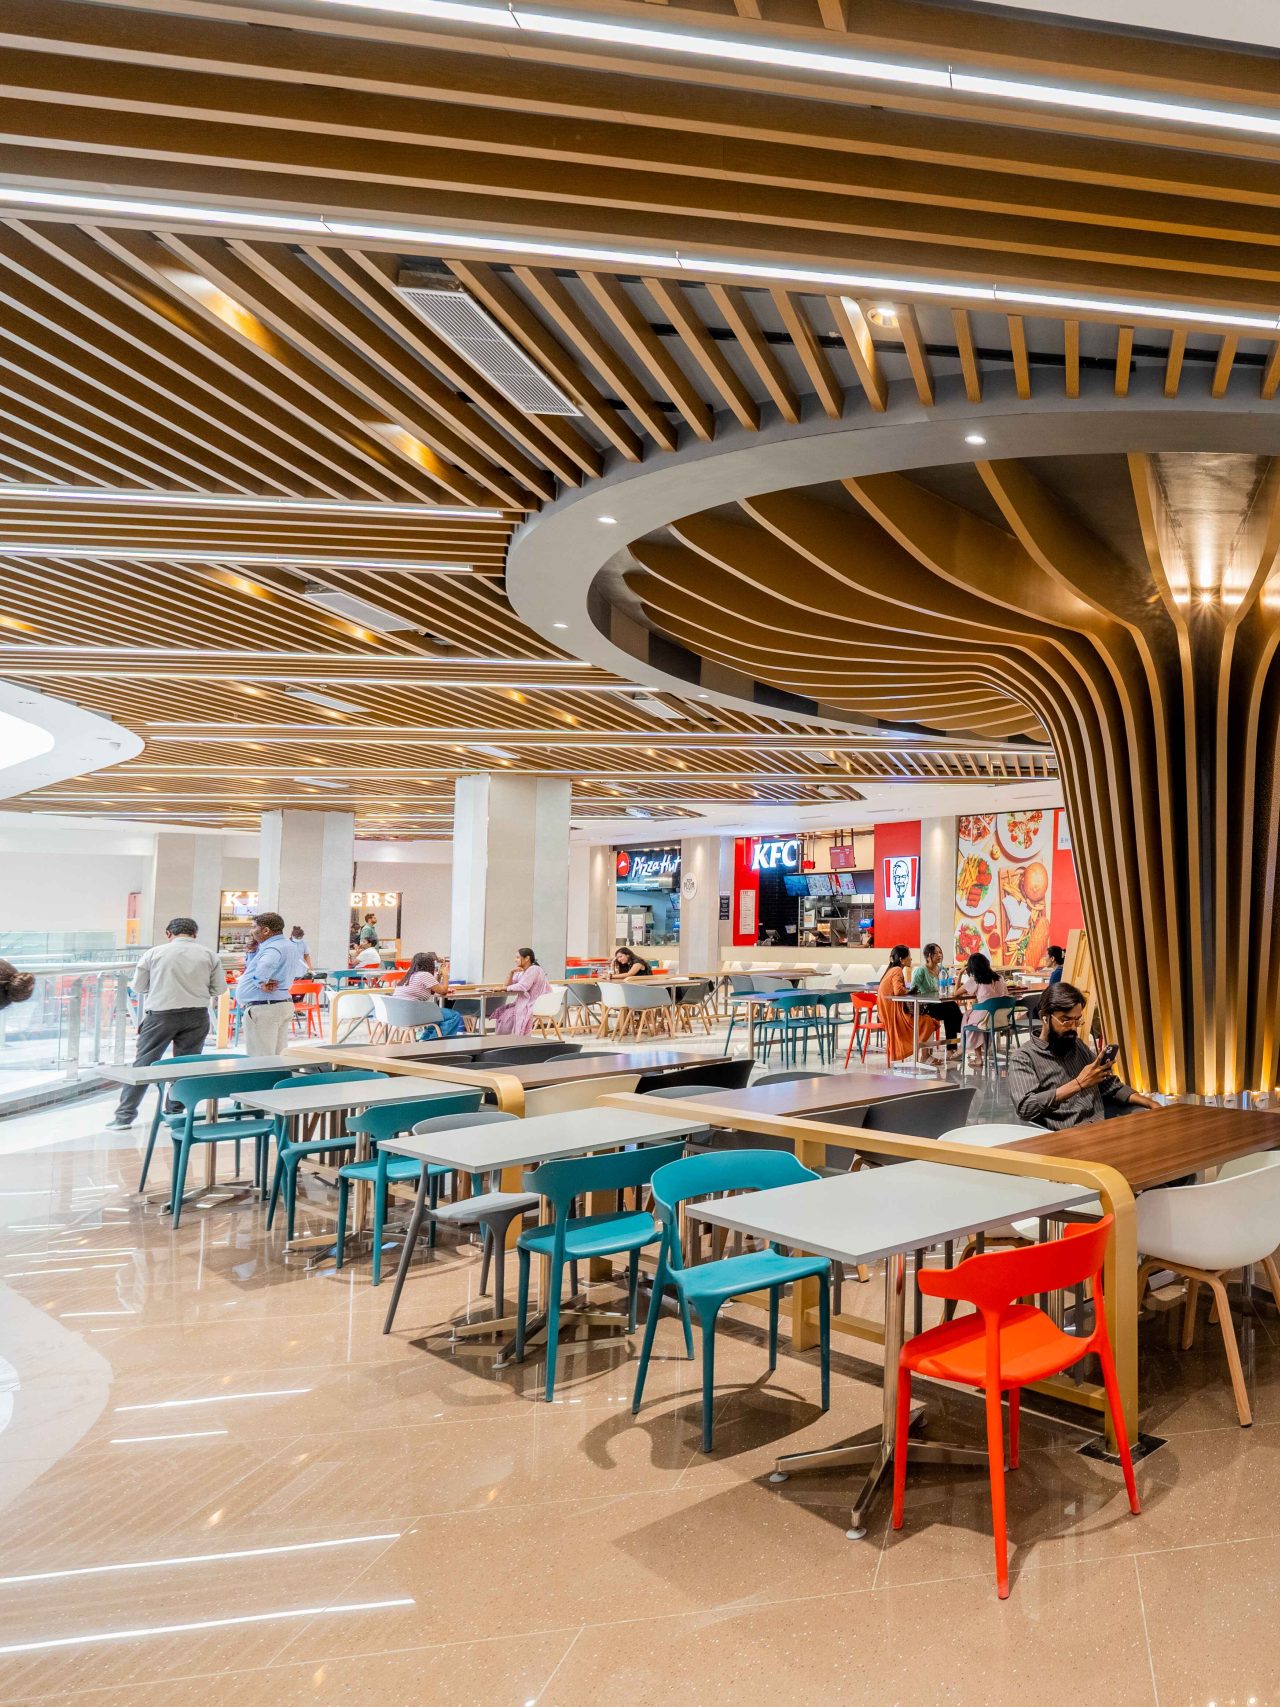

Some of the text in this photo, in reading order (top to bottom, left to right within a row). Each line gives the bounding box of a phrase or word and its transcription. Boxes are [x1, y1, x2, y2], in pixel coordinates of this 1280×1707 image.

[632, 854, 682, 878] Pizza Hut
[752, 840, 798, 870] KFC
